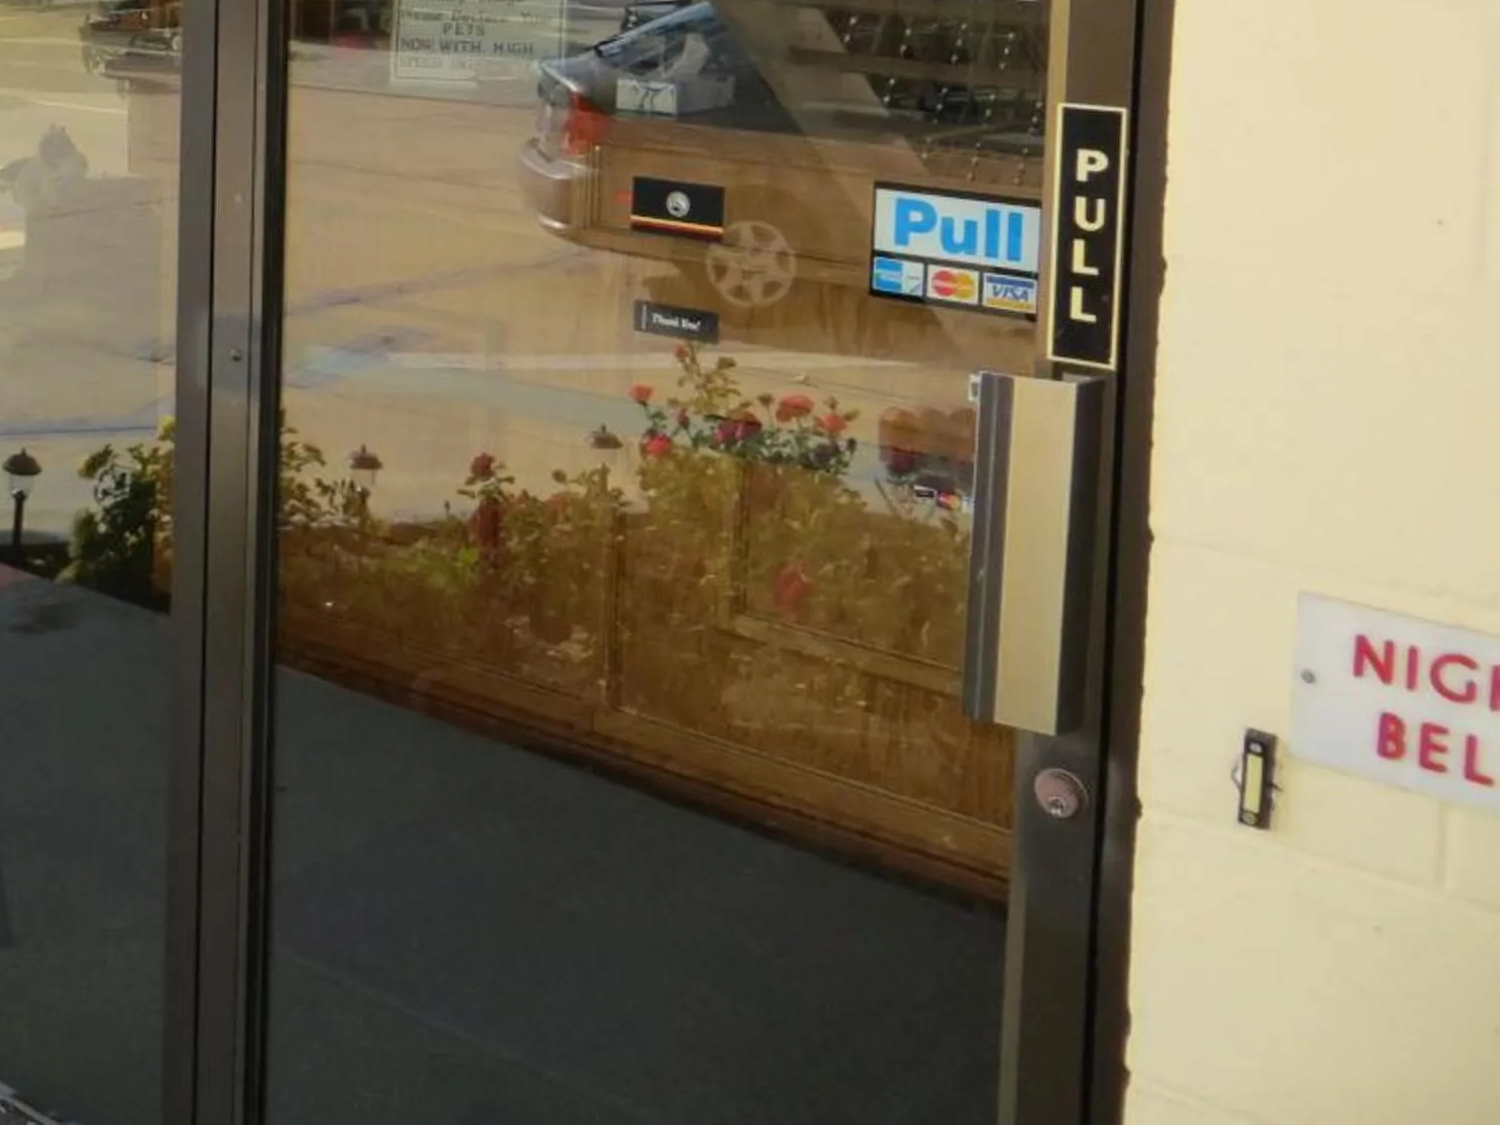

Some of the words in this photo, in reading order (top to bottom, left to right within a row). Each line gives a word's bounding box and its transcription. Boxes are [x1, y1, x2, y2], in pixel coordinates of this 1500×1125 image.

[442, 22, 485, 36] PETS
[895, 197, 1023, 263] Pull
[1070, 148, 1109, 323] PULL
[992, 285, 1029, 302] VISA
[1376, 711, 1495, 788] BEL
